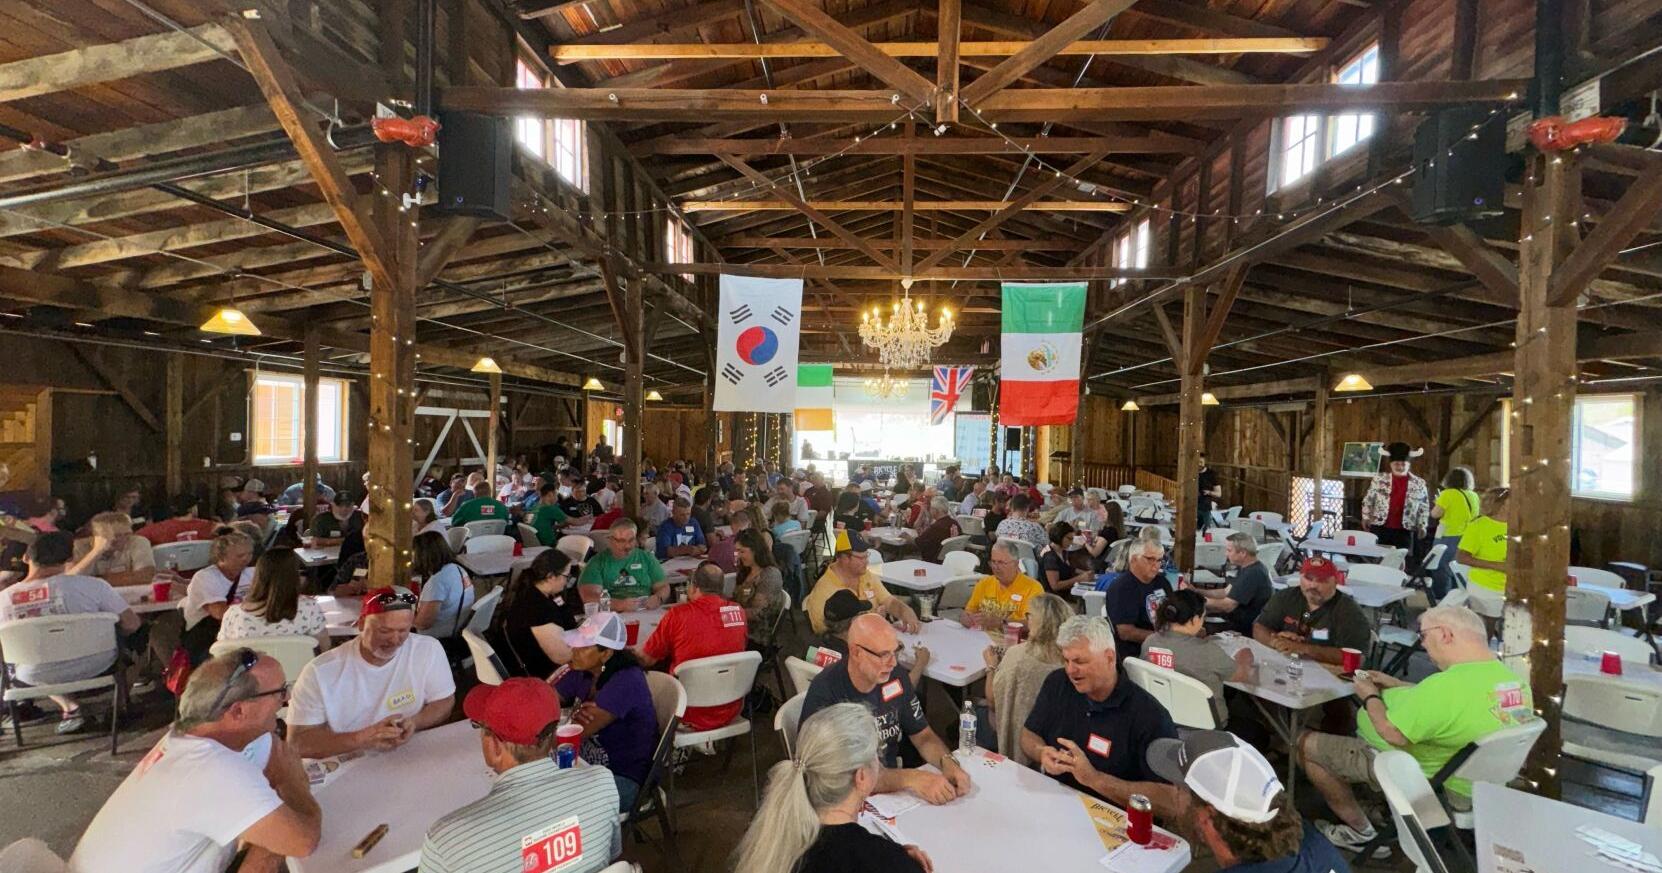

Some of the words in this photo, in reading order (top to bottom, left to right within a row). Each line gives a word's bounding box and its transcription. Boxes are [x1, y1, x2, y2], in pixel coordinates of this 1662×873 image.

[28, 590, 44, 602] 54
[729, 611, 742, 622] 111
[1157, 655, 1172, 667] 169
[1507, 690, 1521, 706] 170
[543, 831, 577, 865] 109
